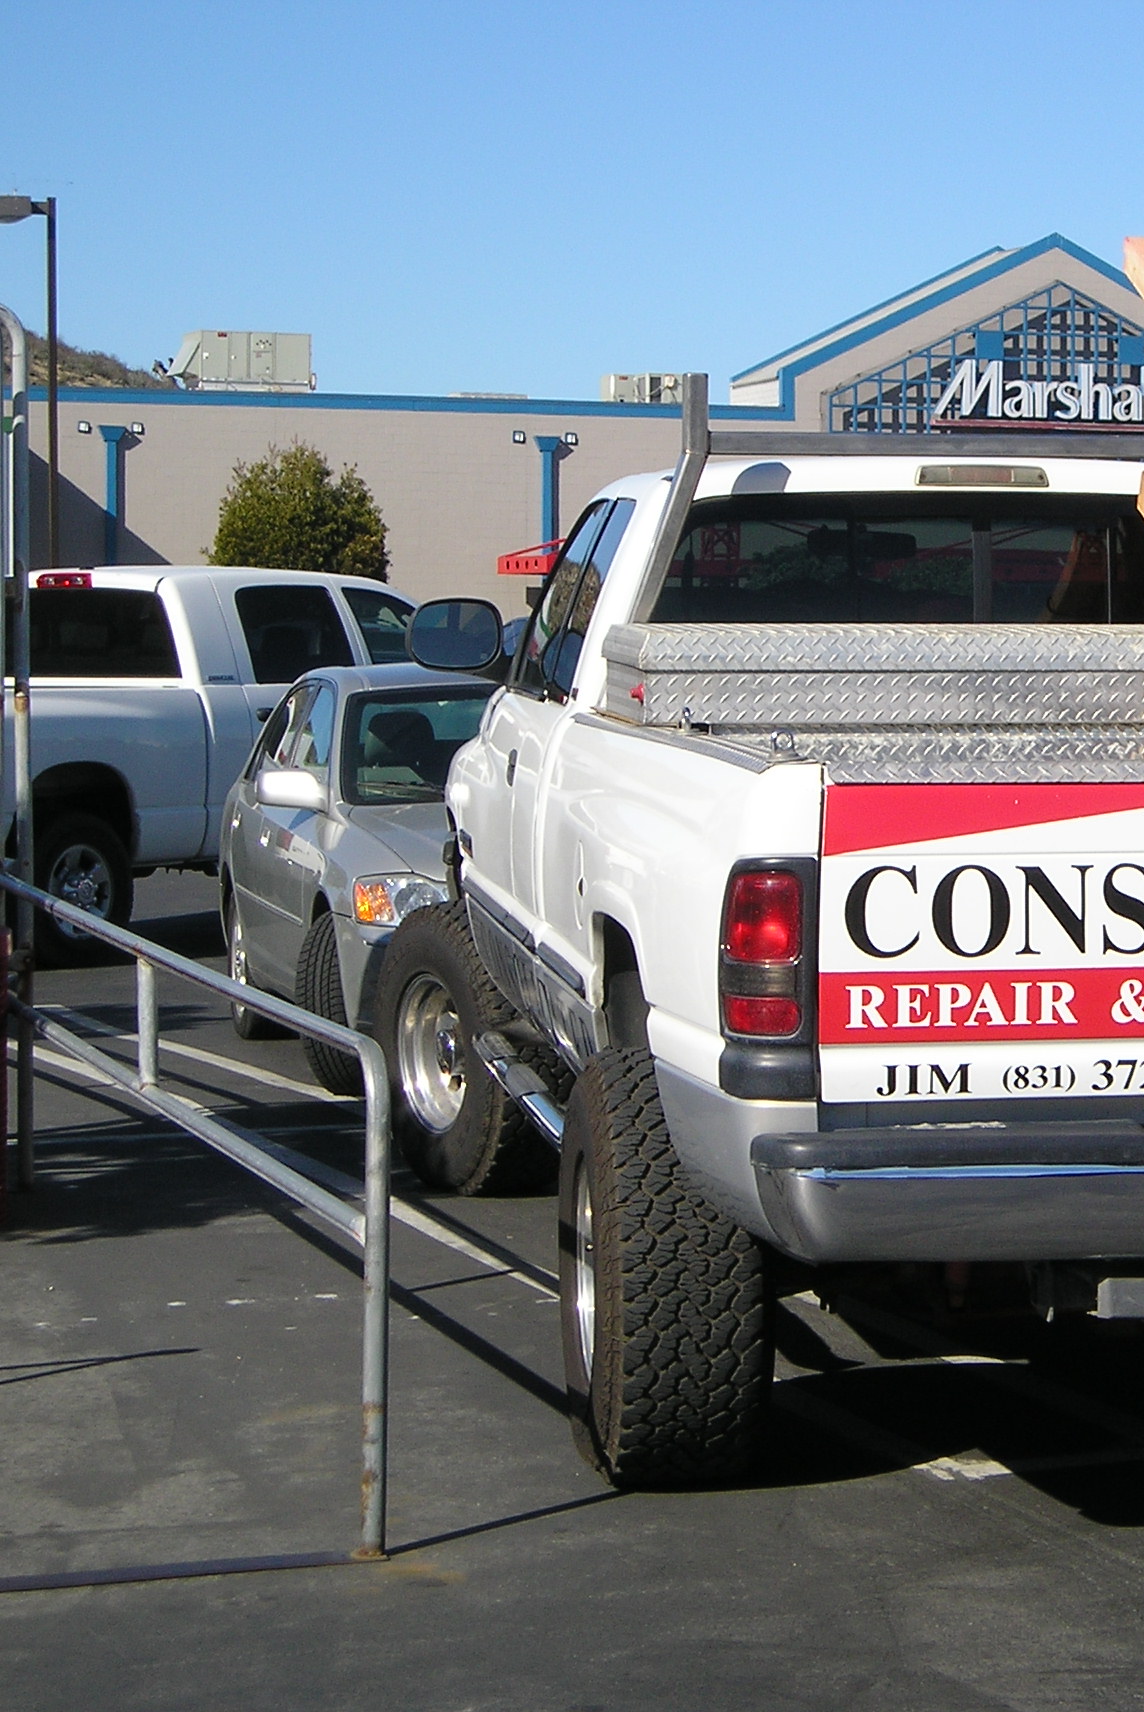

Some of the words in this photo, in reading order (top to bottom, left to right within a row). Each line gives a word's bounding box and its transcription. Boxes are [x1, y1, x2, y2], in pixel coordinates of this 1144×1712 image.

[845, 981, 1078, 1029] REPAIR
[876, 1063, 972, 1096] JIM
[1002, 1064, 1077, 1093] (831)
